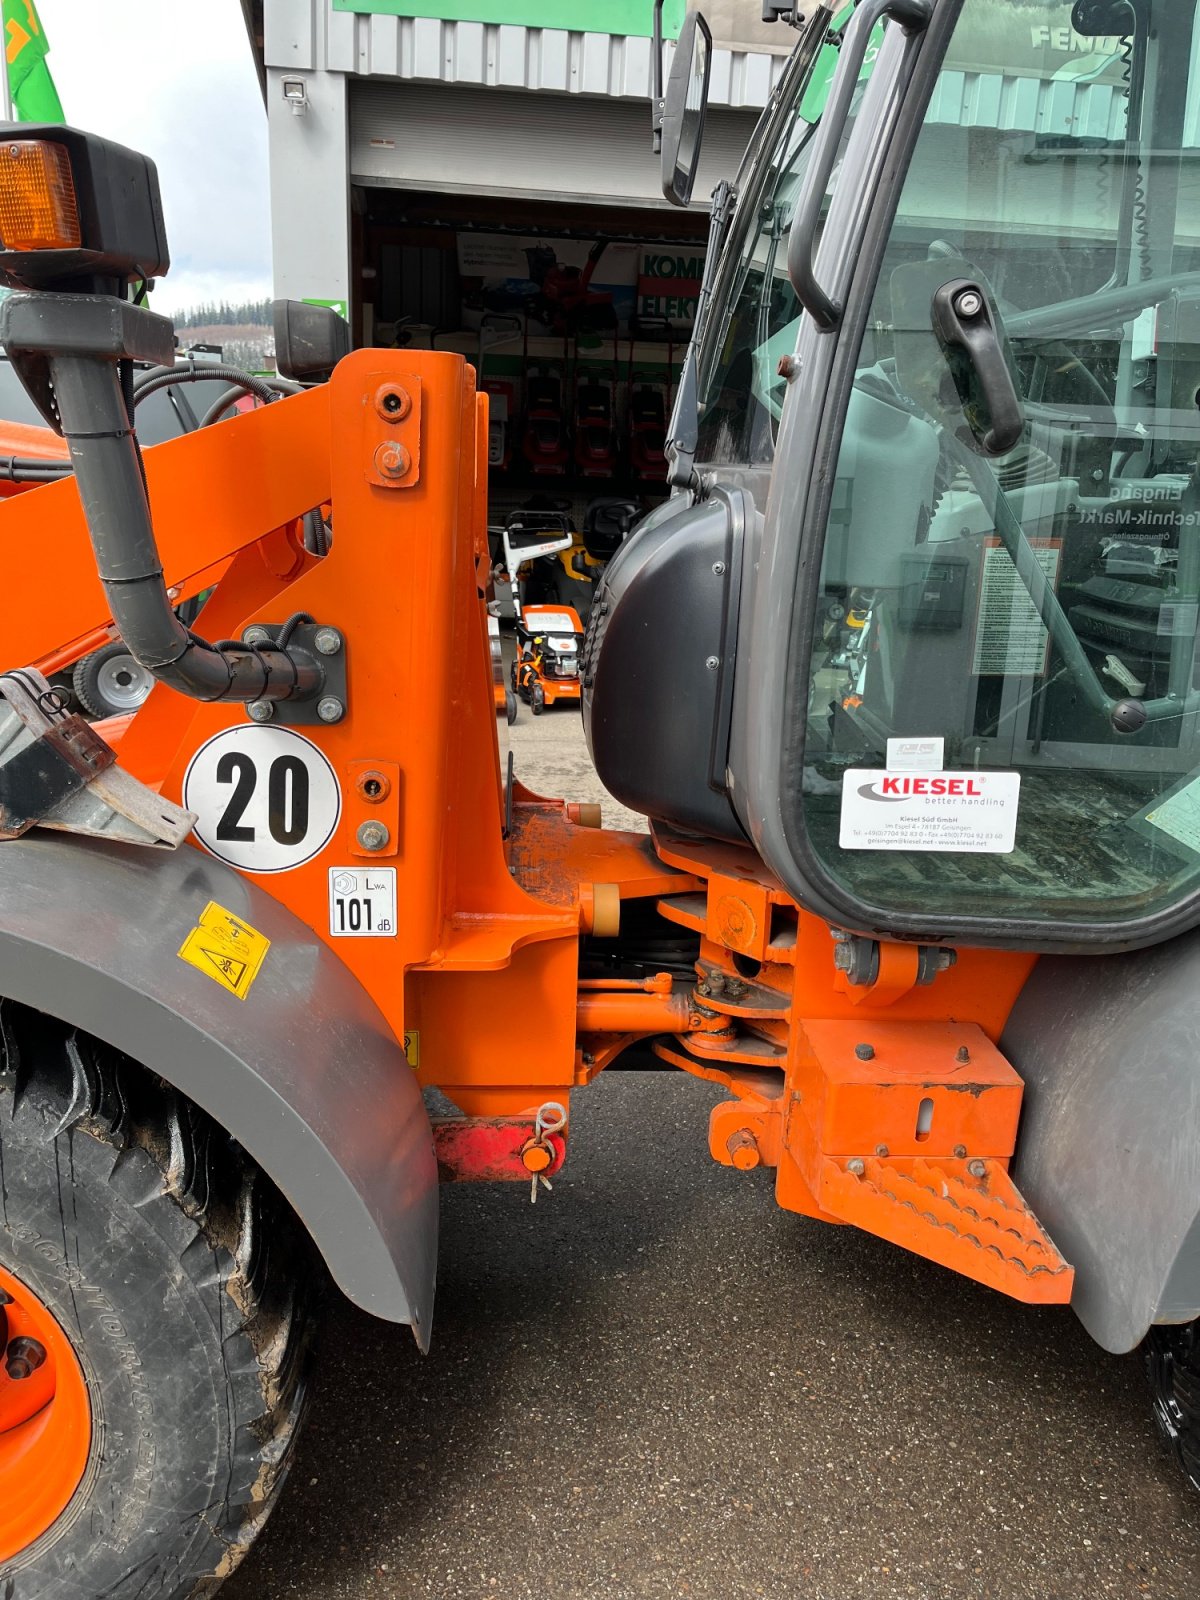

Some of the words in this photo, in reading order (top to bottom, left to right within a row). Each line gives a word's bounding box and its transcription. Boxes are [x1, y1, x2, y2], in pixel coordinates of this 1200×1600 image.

[1031, 25, 1121, 55] FEND
[216, 752, 309, 846] 20
[925, 797, 957, 805] better
[961, 797, 1005, 807] handling
[336, 898, 372, 931] 101
[377, 919, 391, 931] dB
